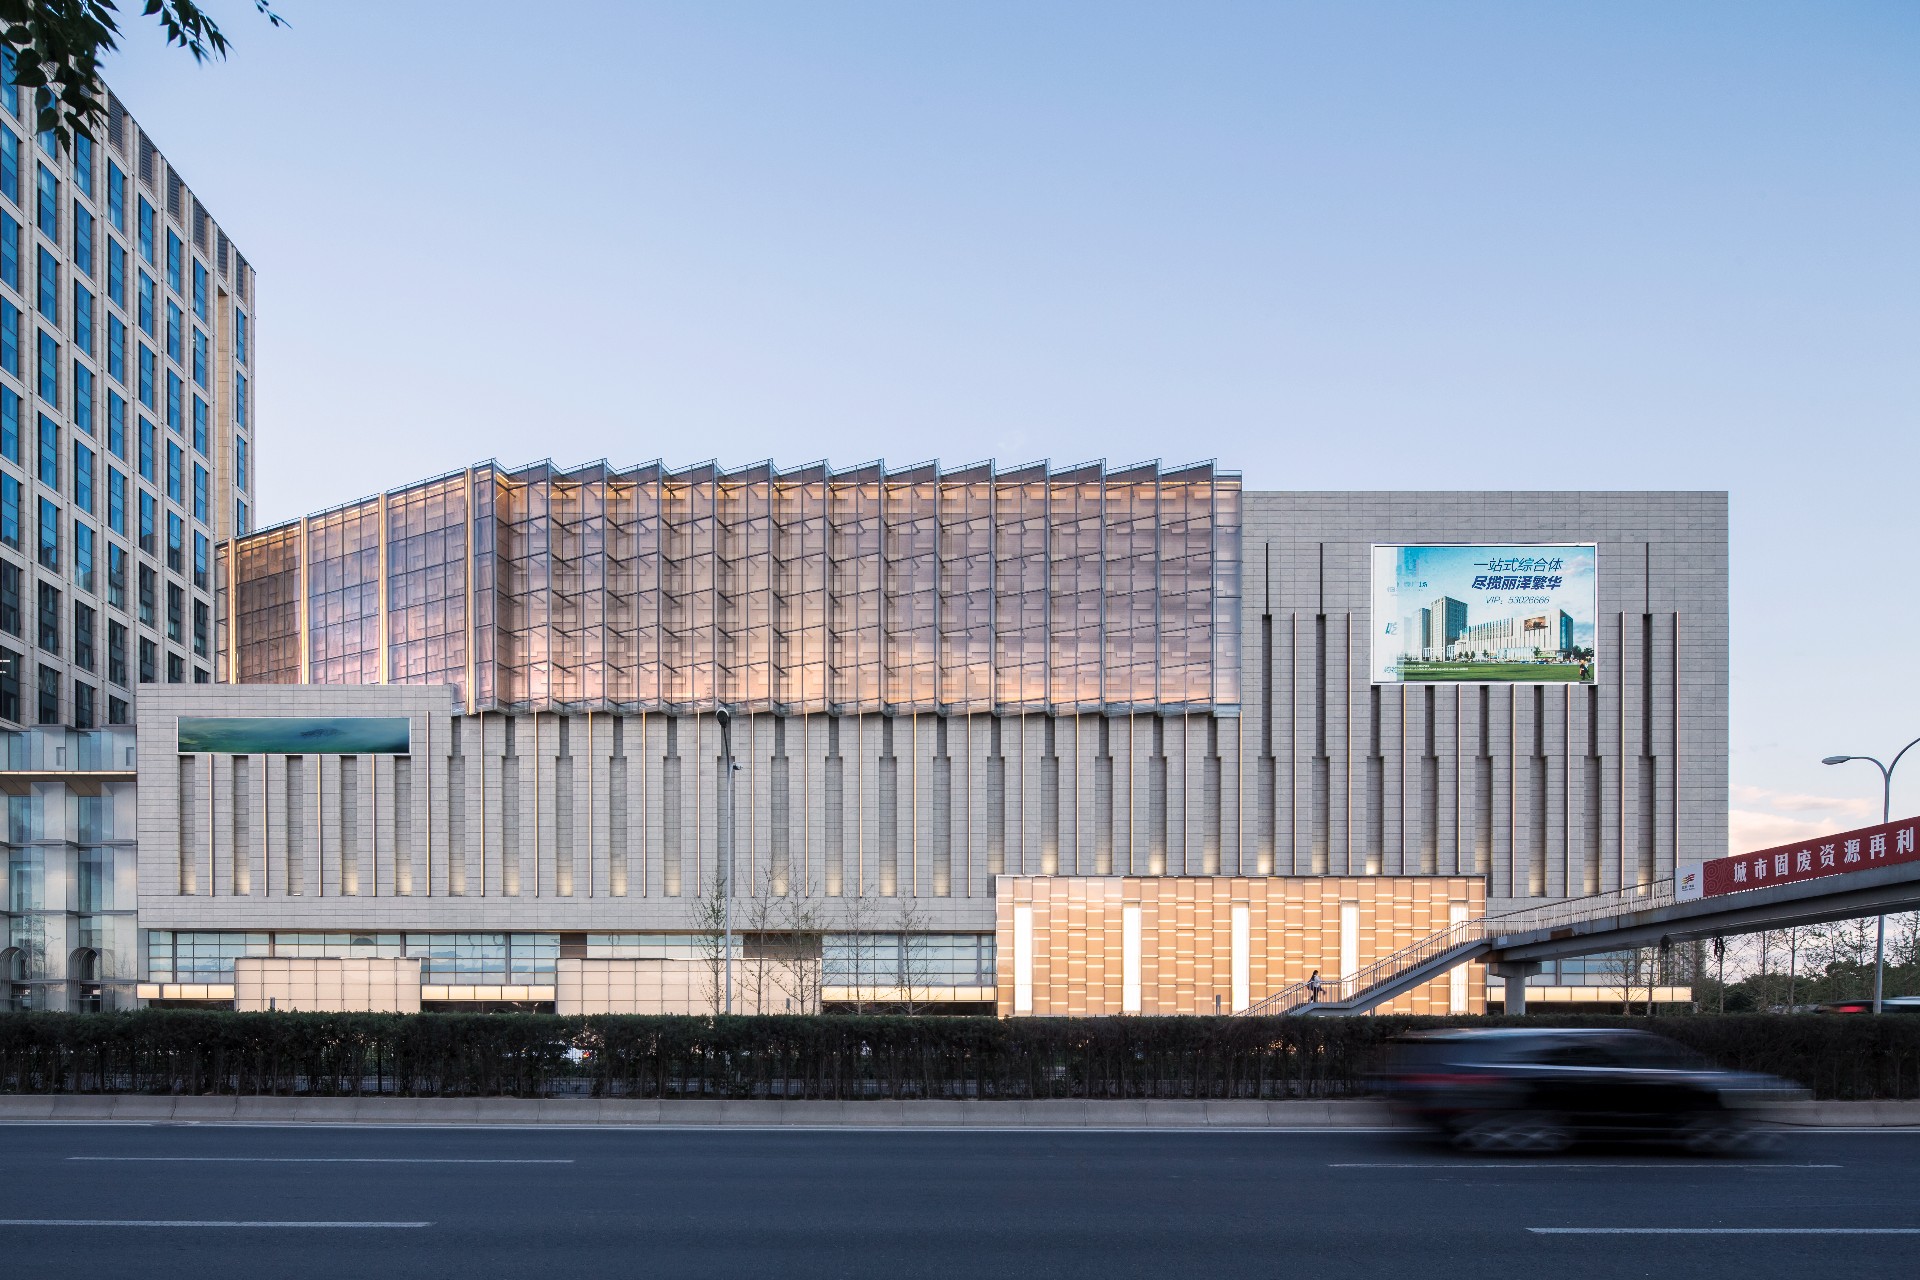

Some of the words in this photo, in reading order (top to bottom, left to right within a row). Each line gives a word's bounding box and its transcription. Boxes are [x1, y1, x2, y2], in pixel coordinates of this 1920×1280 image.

[1474, 557, 1563, 572] 一站式综合体
[1472, 575, 1562, 590] 尽揽丽泽繁华
[1733, 827, 1915, 884] 城市固废资源再利
